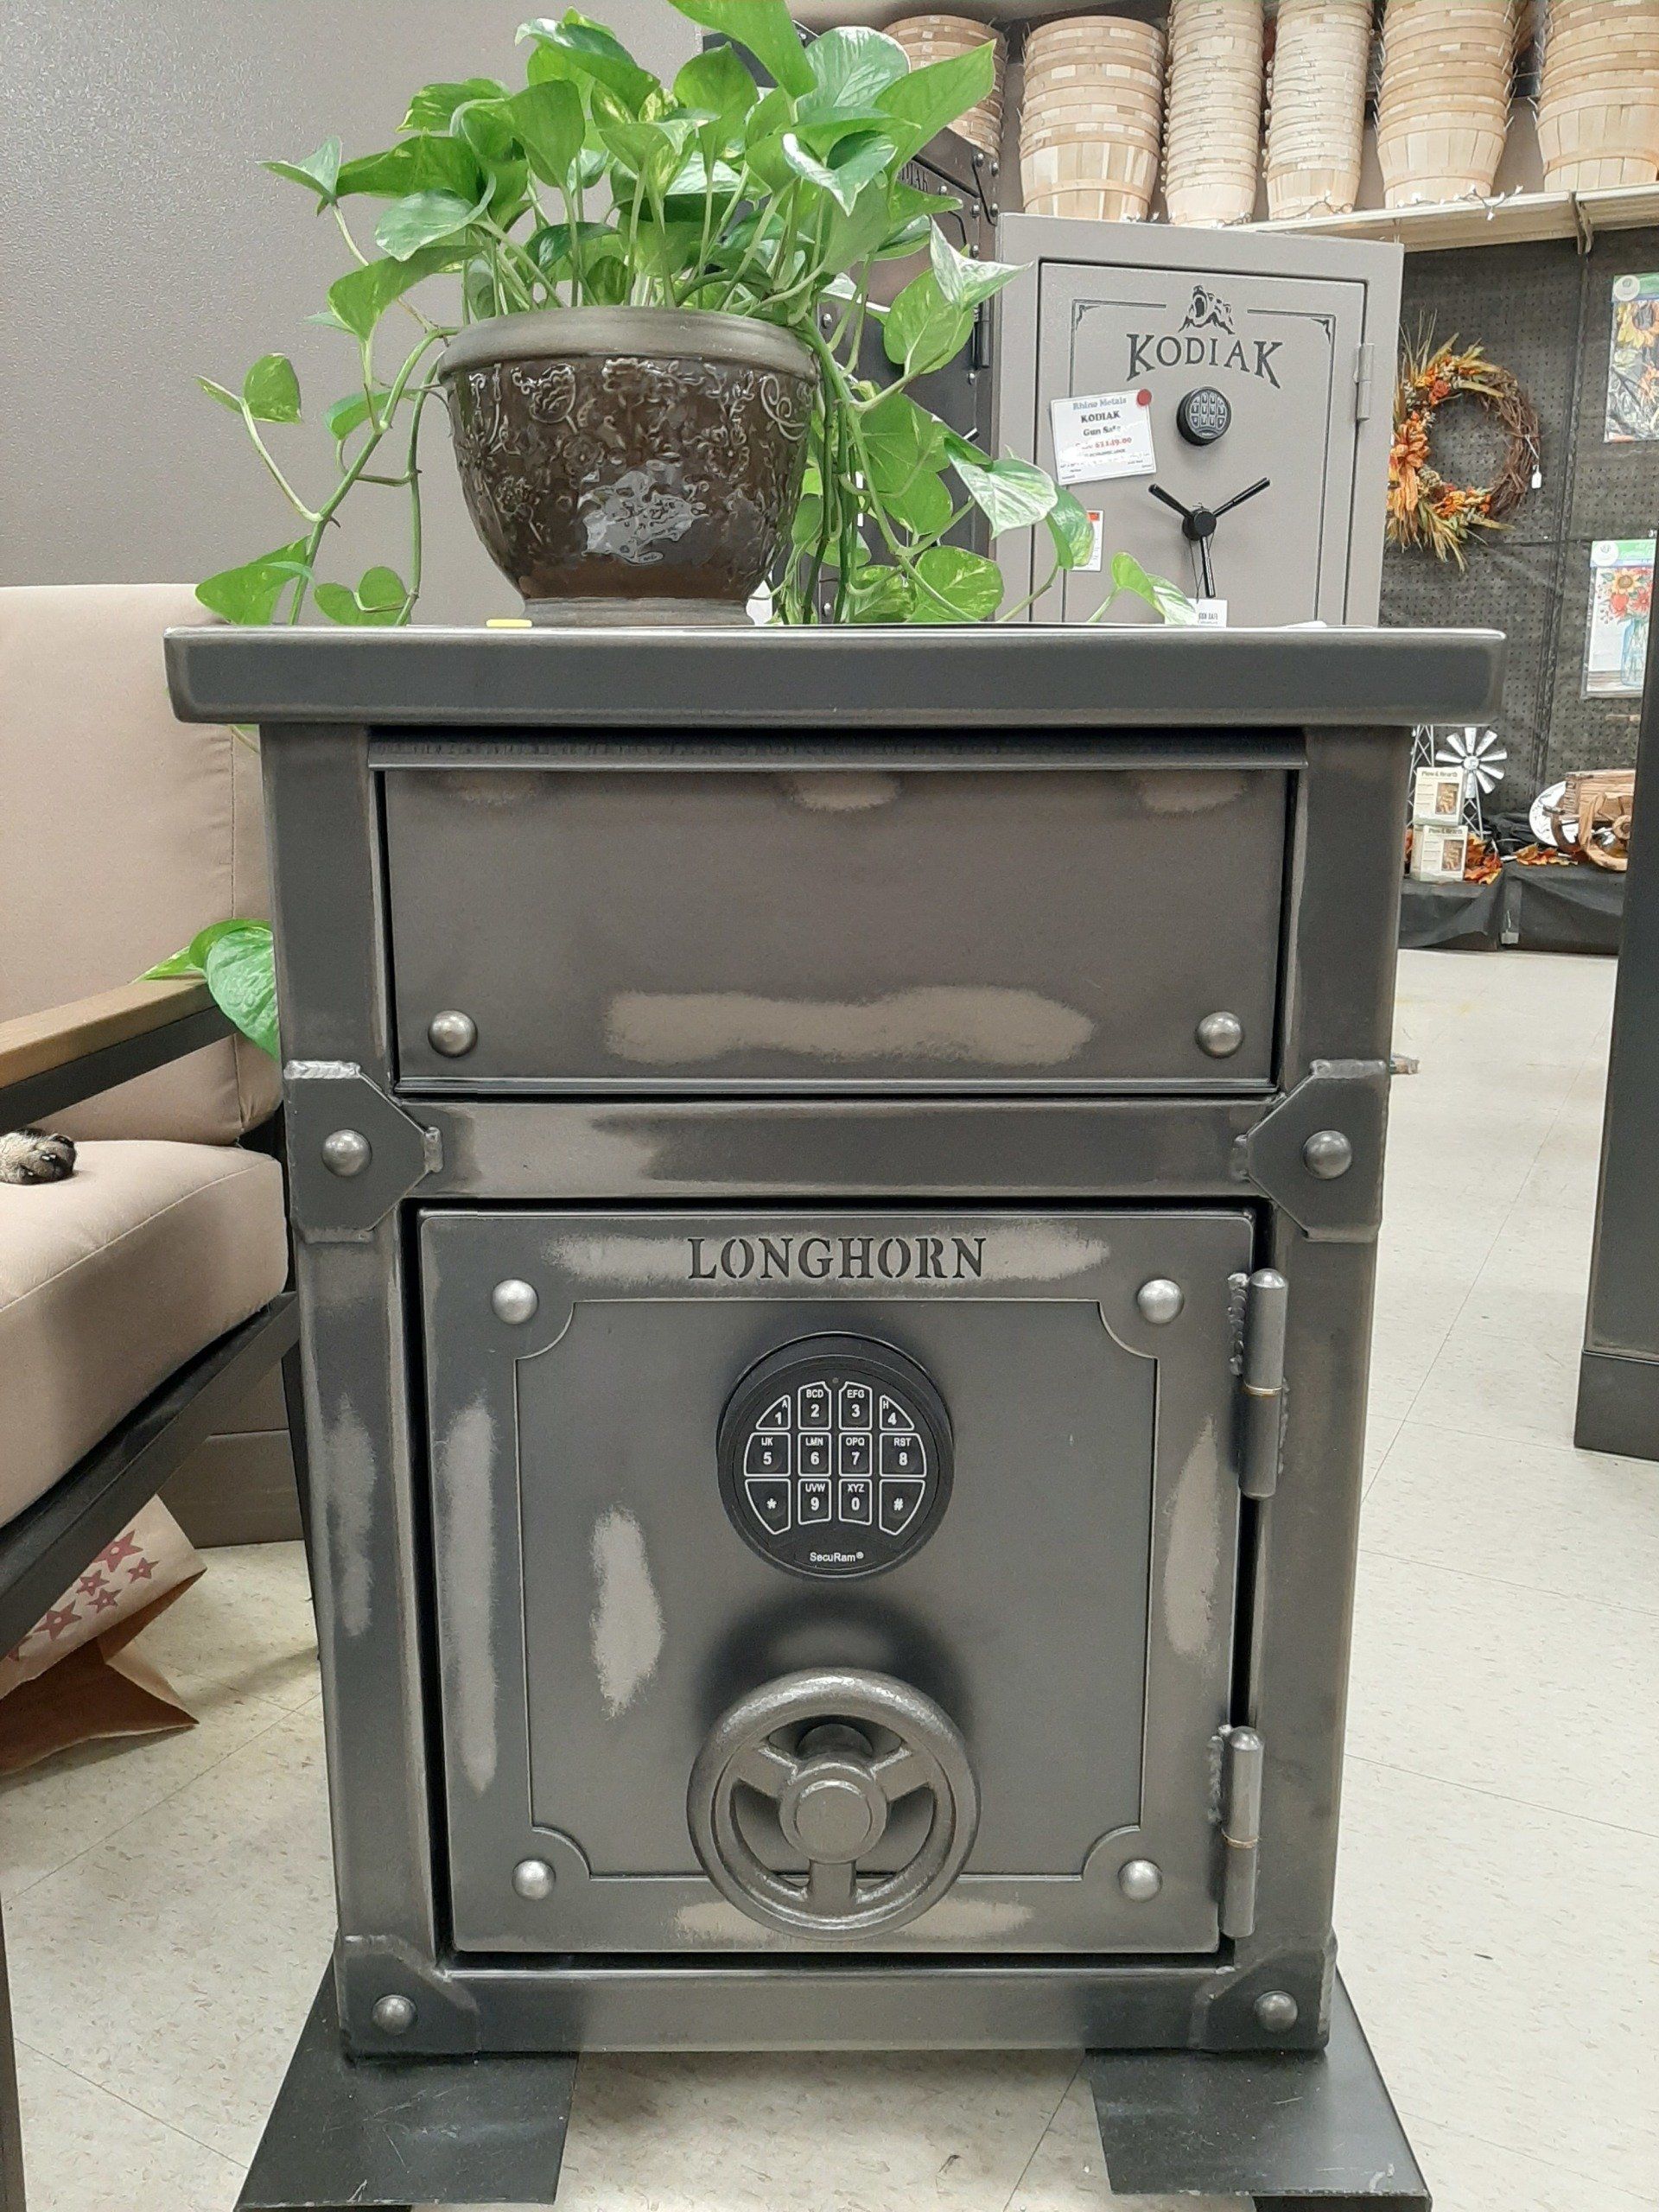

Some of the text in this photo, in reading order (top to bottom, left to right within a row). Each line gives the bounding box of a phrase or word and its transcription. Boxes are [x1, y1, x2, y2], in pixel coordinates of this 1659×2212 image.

[1126, 333, 1283, 389] KODIAK
[1099, 397, 1127, 408] Metals
[1080, 410, 1122, 423] KODIAK
[1083, 428, 1102, 436] Gun
[688, 1236, 987, 1280] LONGHORN
[805, 1389, 824, 1398] BCD
[847, 1389, 865, 1399] EFG
[781, 1399, 788, 1408] A
[882, 1400, 889, 1409] H
[810, 1404, 820, 1418] 2
[851, 1404, 861, 1418] 3
[774, 1412, 782, 1425] 1
[887, 1412, 897, 1426] 4
[805, 1437, 824, 1446] LMN
[846, 1437, 865, 1446] OPQ
[893, 1437, 912, 1446] RST
[763, 1452, 772, 1465] 5
[810, 1452, 820, 1465] 6
[851, 1452, 861, 1465] 7
[899, 1452, 908, 1465] 8
[804, 1484, 826, 1492] UVW
[847, 1484, 865, 1492] XYZ
[810, 1497, 820, 1510] 9
[851, 1497, 861, 1510] 0
